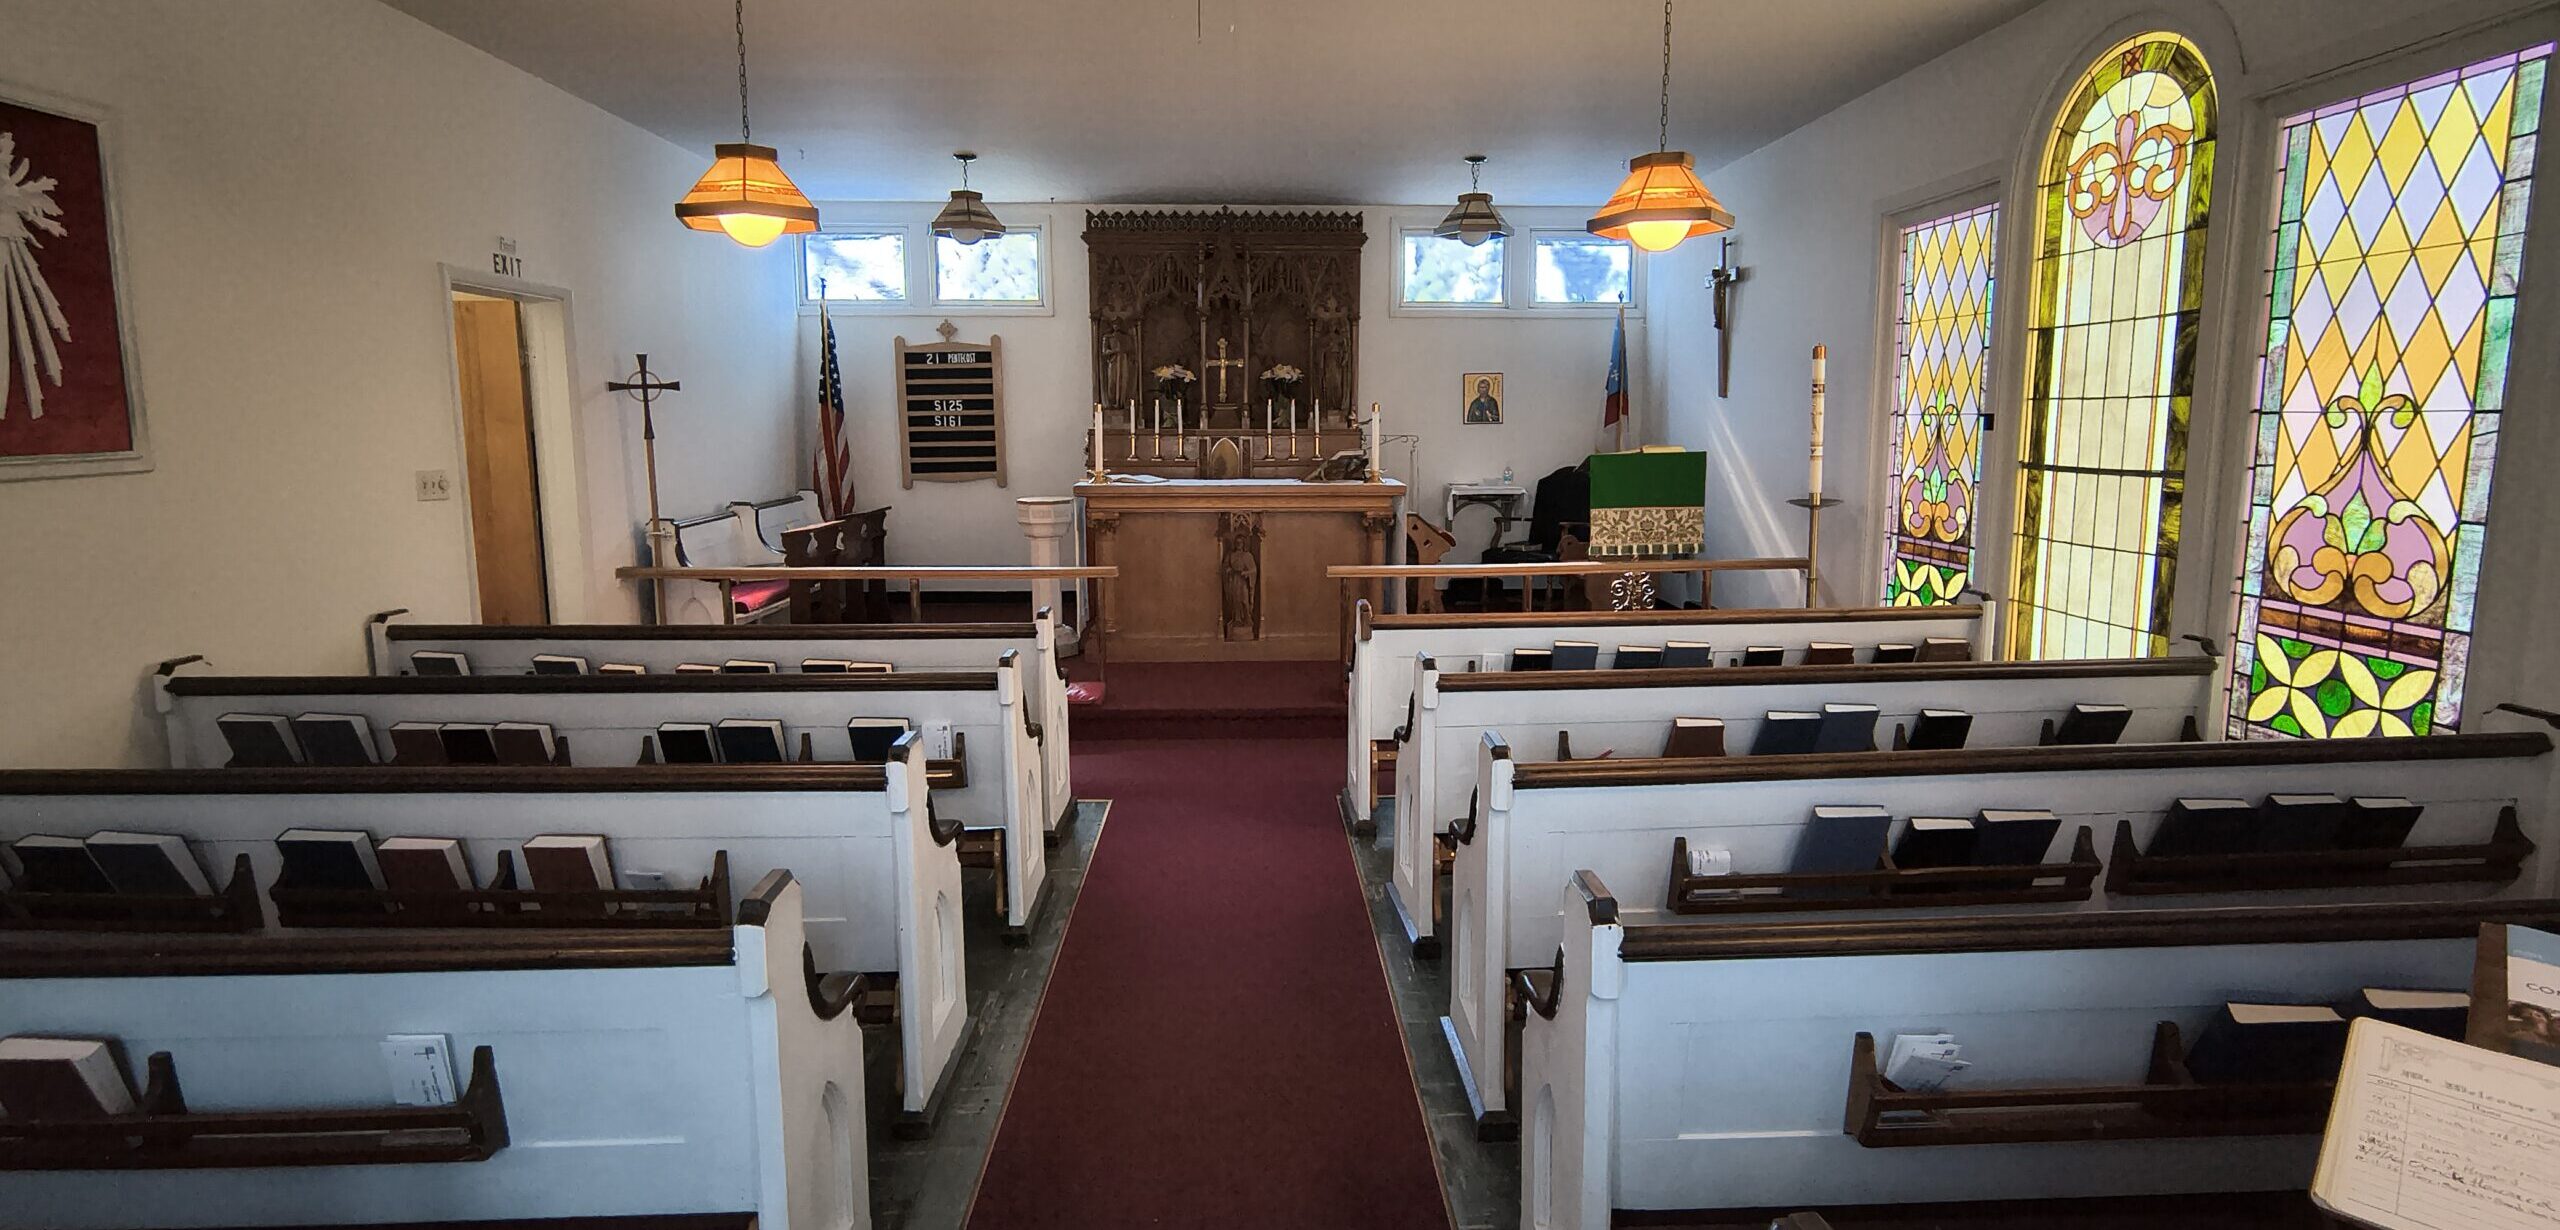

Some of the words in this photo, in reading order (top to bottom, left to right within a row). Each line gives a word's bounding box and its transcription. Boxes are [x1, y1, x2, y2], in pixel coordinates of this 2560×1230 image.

[493, 253, 521, 278] EXIT
[926, 353, 939, 365] 21
[934, 400, 963, 411] S125
[934, 415, 961, 427] S161
